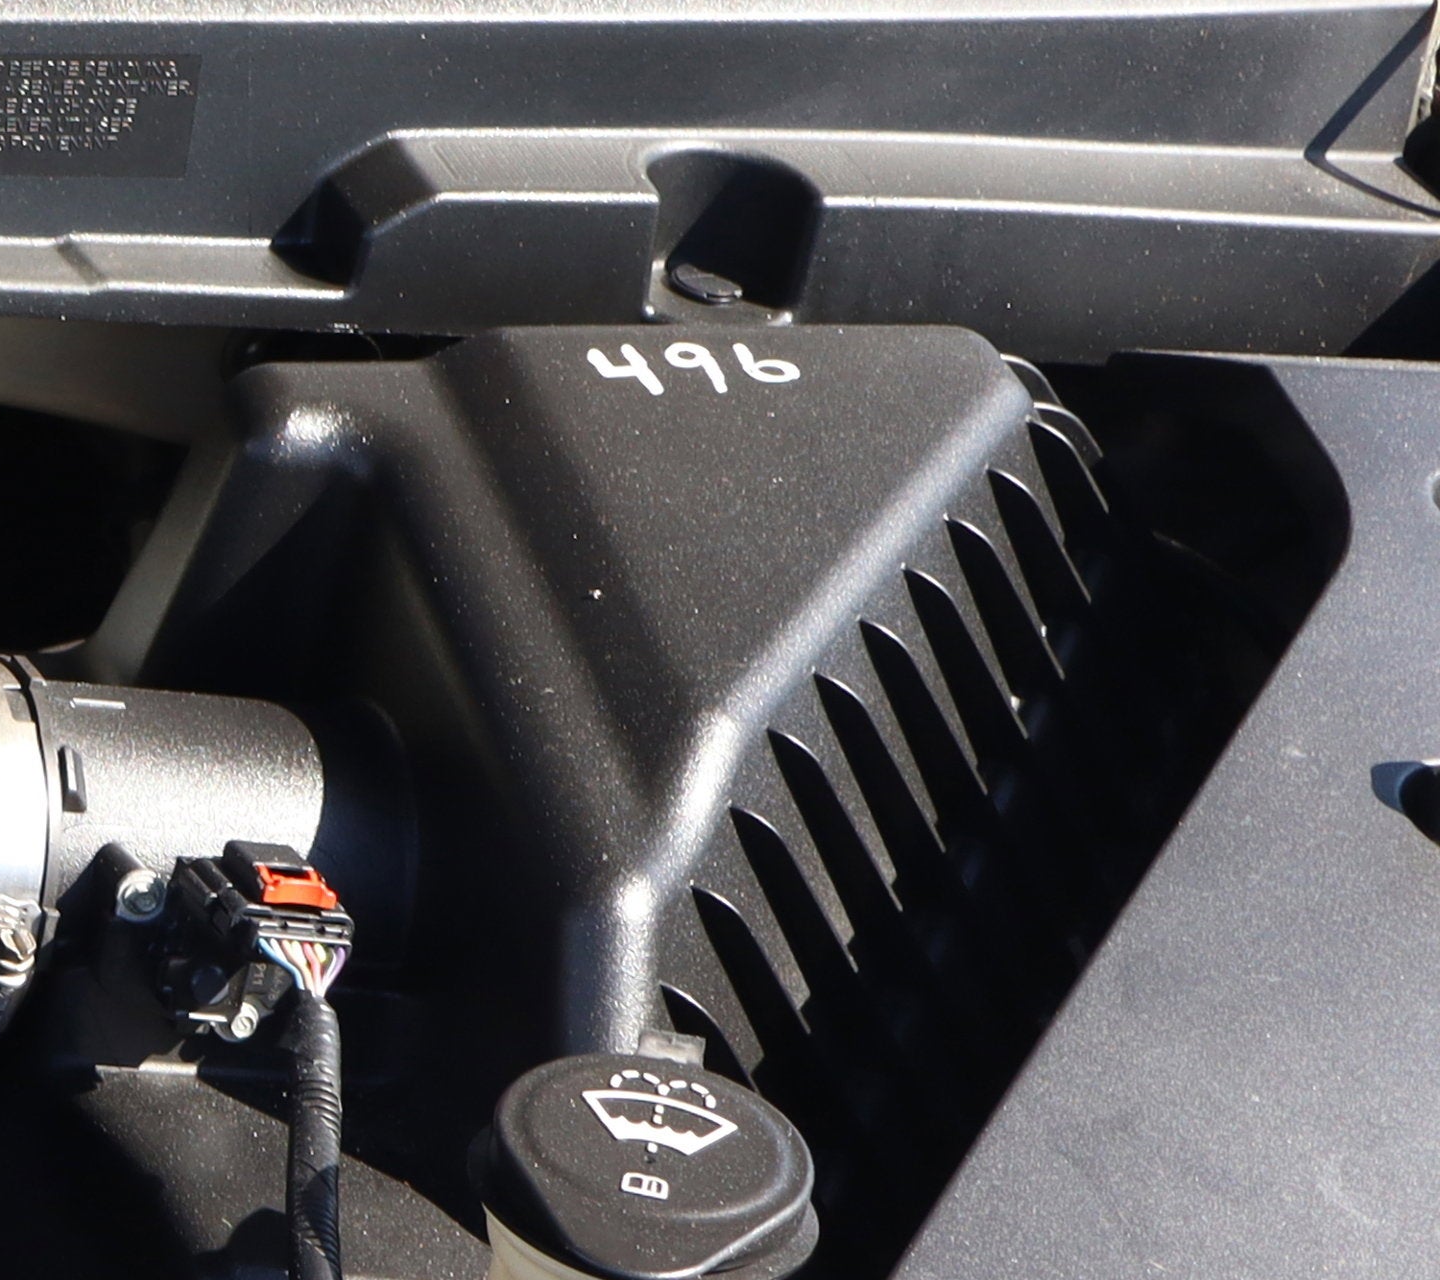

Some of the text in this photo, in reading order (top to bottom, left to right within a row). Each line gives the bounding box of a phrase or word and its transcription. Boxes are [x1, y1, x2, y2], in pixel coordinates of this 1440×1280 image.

[9, 59, 80, 77] BEFORE
[5, 78, 16, 96] A
[18, 78, 86, 96] SEALED
[586, 341, 801, 396] 496
